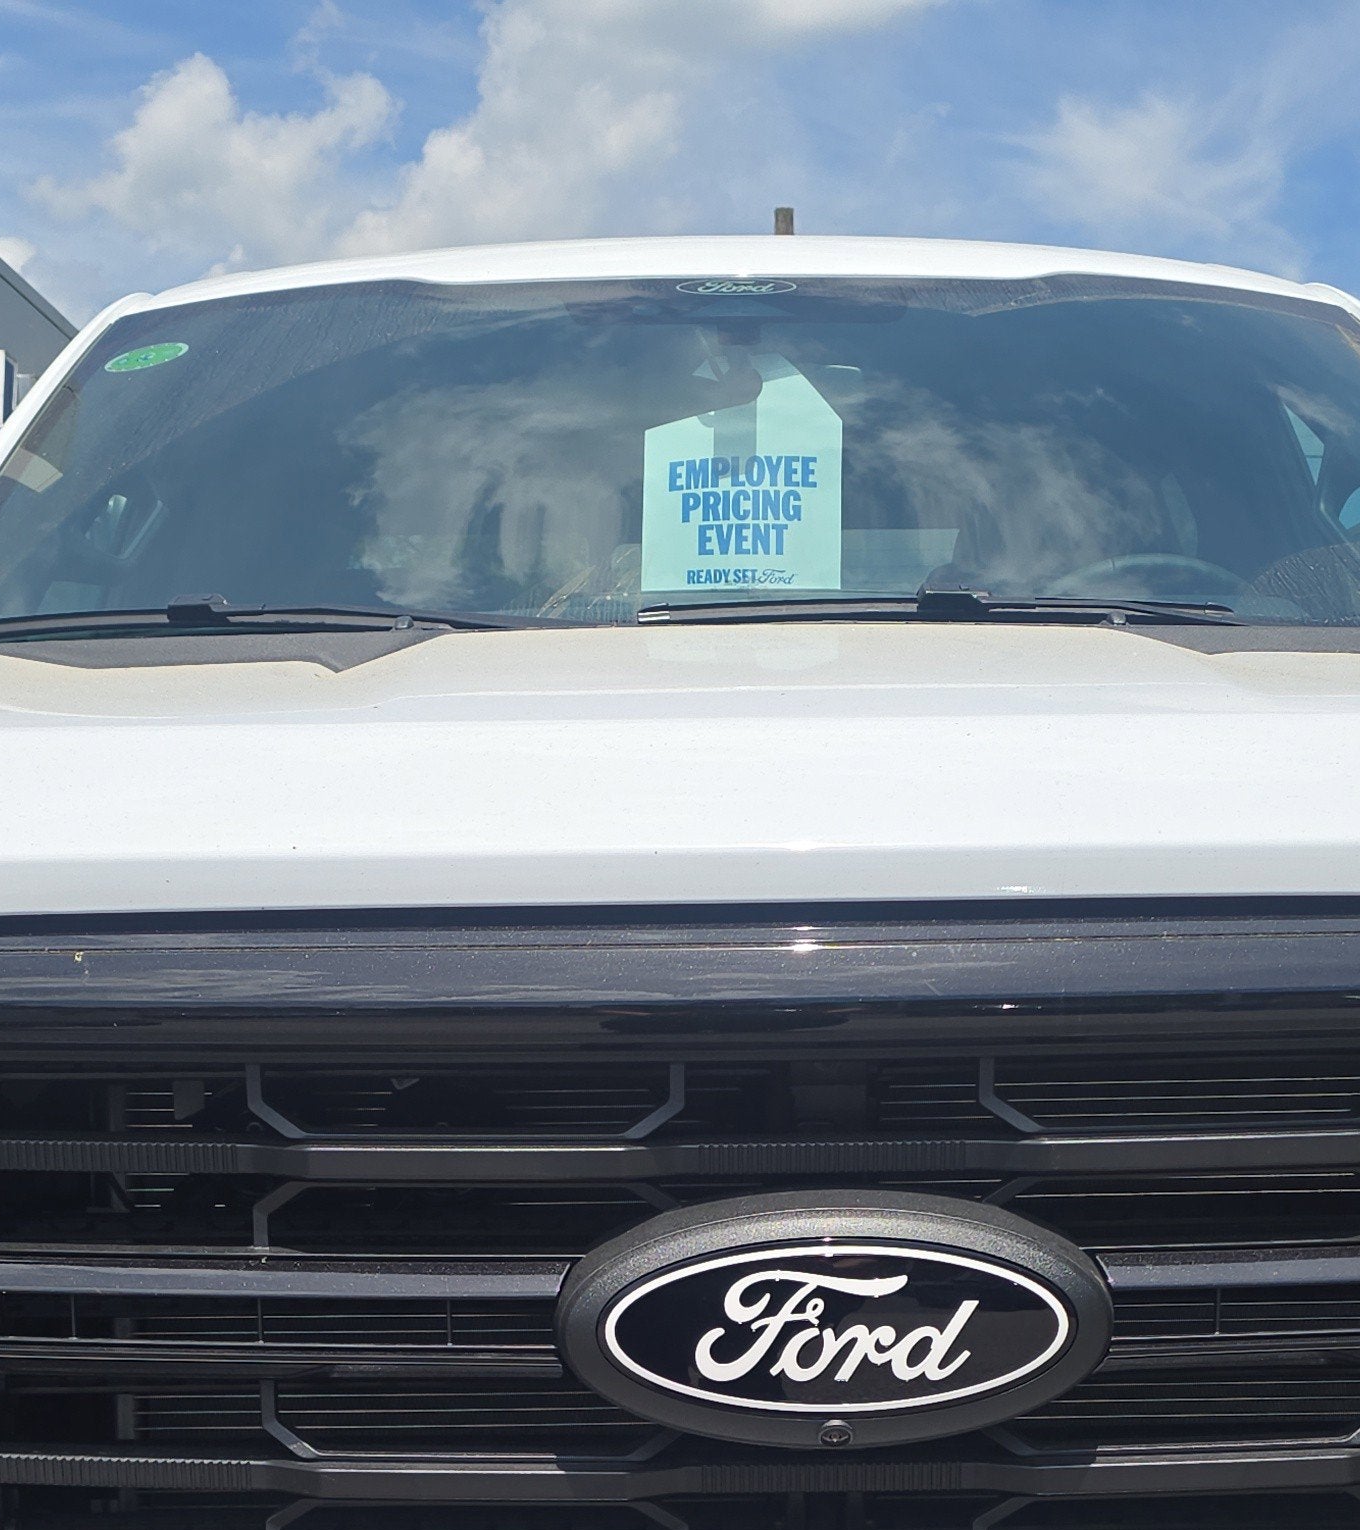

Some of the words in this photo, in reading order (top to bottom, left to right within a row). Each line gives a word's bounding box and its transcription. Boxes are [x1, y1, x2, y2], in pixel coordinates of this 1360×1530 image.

[698, 280, 776, 292] Ford
[668, 455, 818, 492] EMPLOYEE
[681, 489, 802, 523] PRICING
[697, 522, 789, 556] EVENT
[686, 568, 731, 585] READY
[733, 568, 758, 585] SET
[757, 568, 795, 585] Ford
[694, 1269, 980, 1382] Ford
